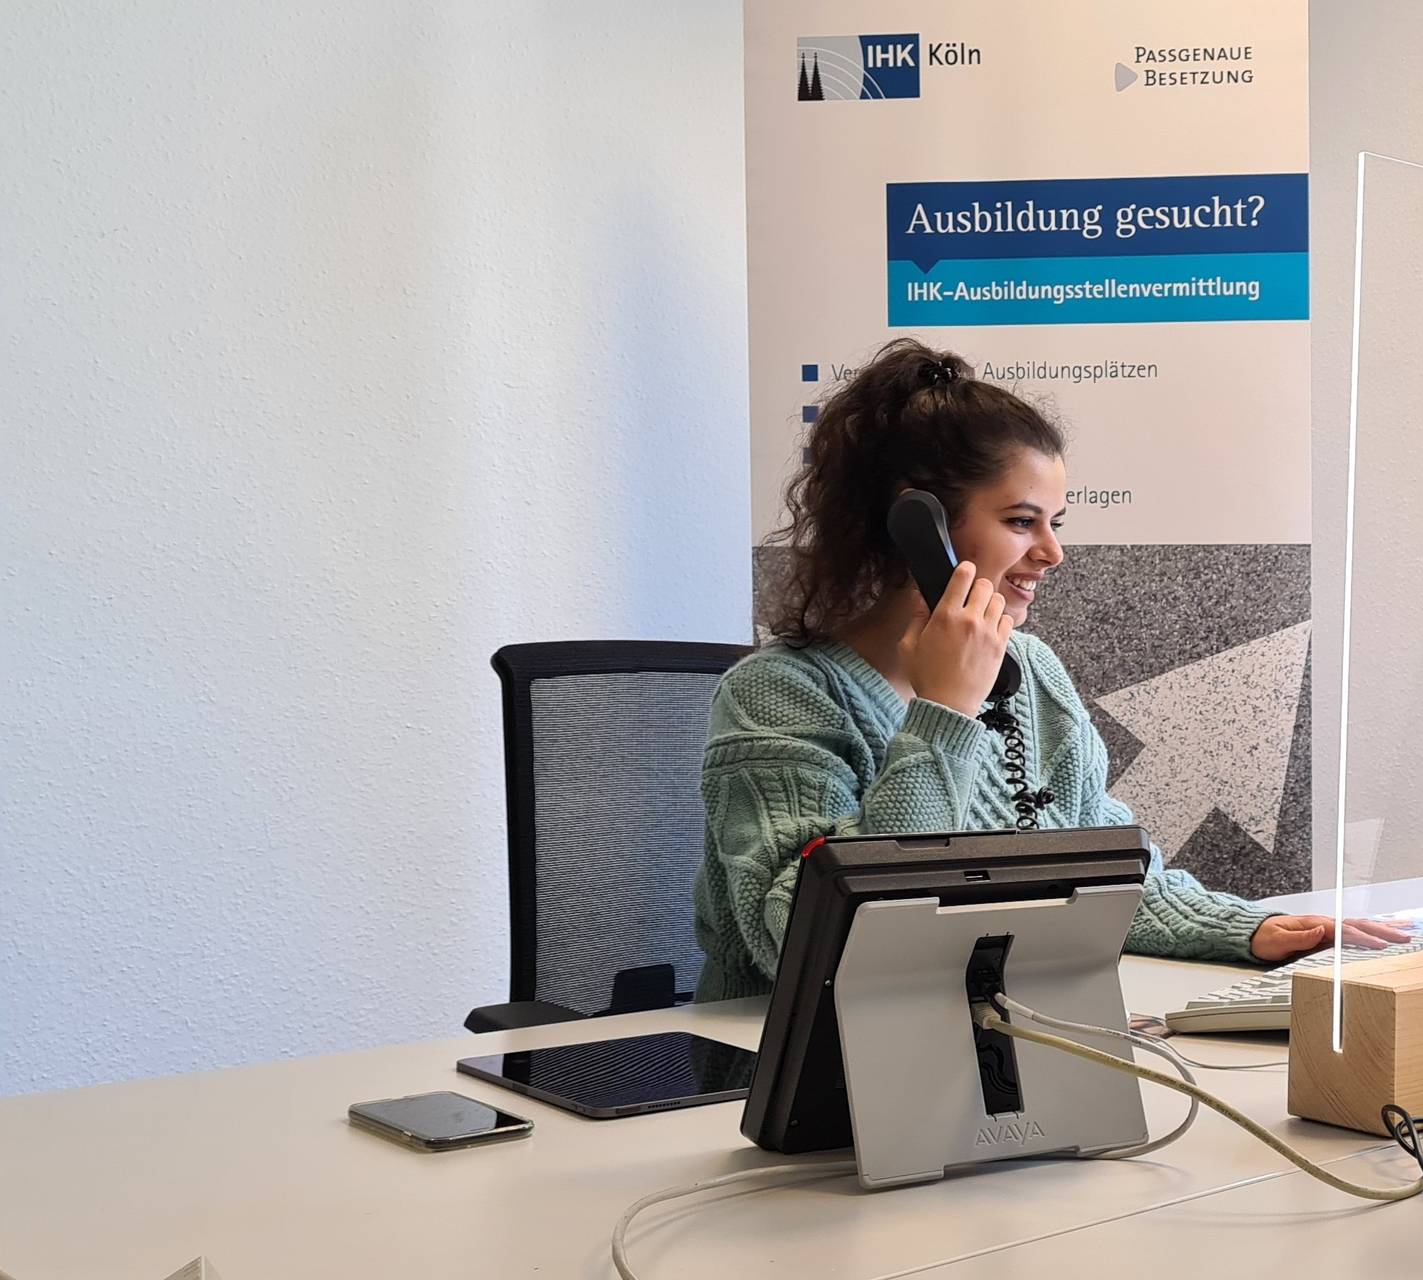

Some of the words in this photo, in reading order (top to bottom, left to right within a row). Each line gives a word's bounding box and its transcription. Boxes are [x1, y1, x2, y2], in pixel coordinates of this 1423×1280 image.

[867, 43, 916, 68] IHK
[928, 42, 982, 66] Köln
[1134, 46, 1253, 64] PASSGENAUE
[1143, 69, 1254, 87] BESETZUNG
[905, 200, 1103, 239] Ausbildung
[1115, 195, 1265, 238] gesucht?
[907, 277, 1261, 304] IHK-Ausbildungsstellenvermittlung
[982, 360, 1159, 384] Ausbildungsplätzen
[1065, 486, 1132, 508] erlagen
[975, 1121, 1045, 1147] AVAYA
